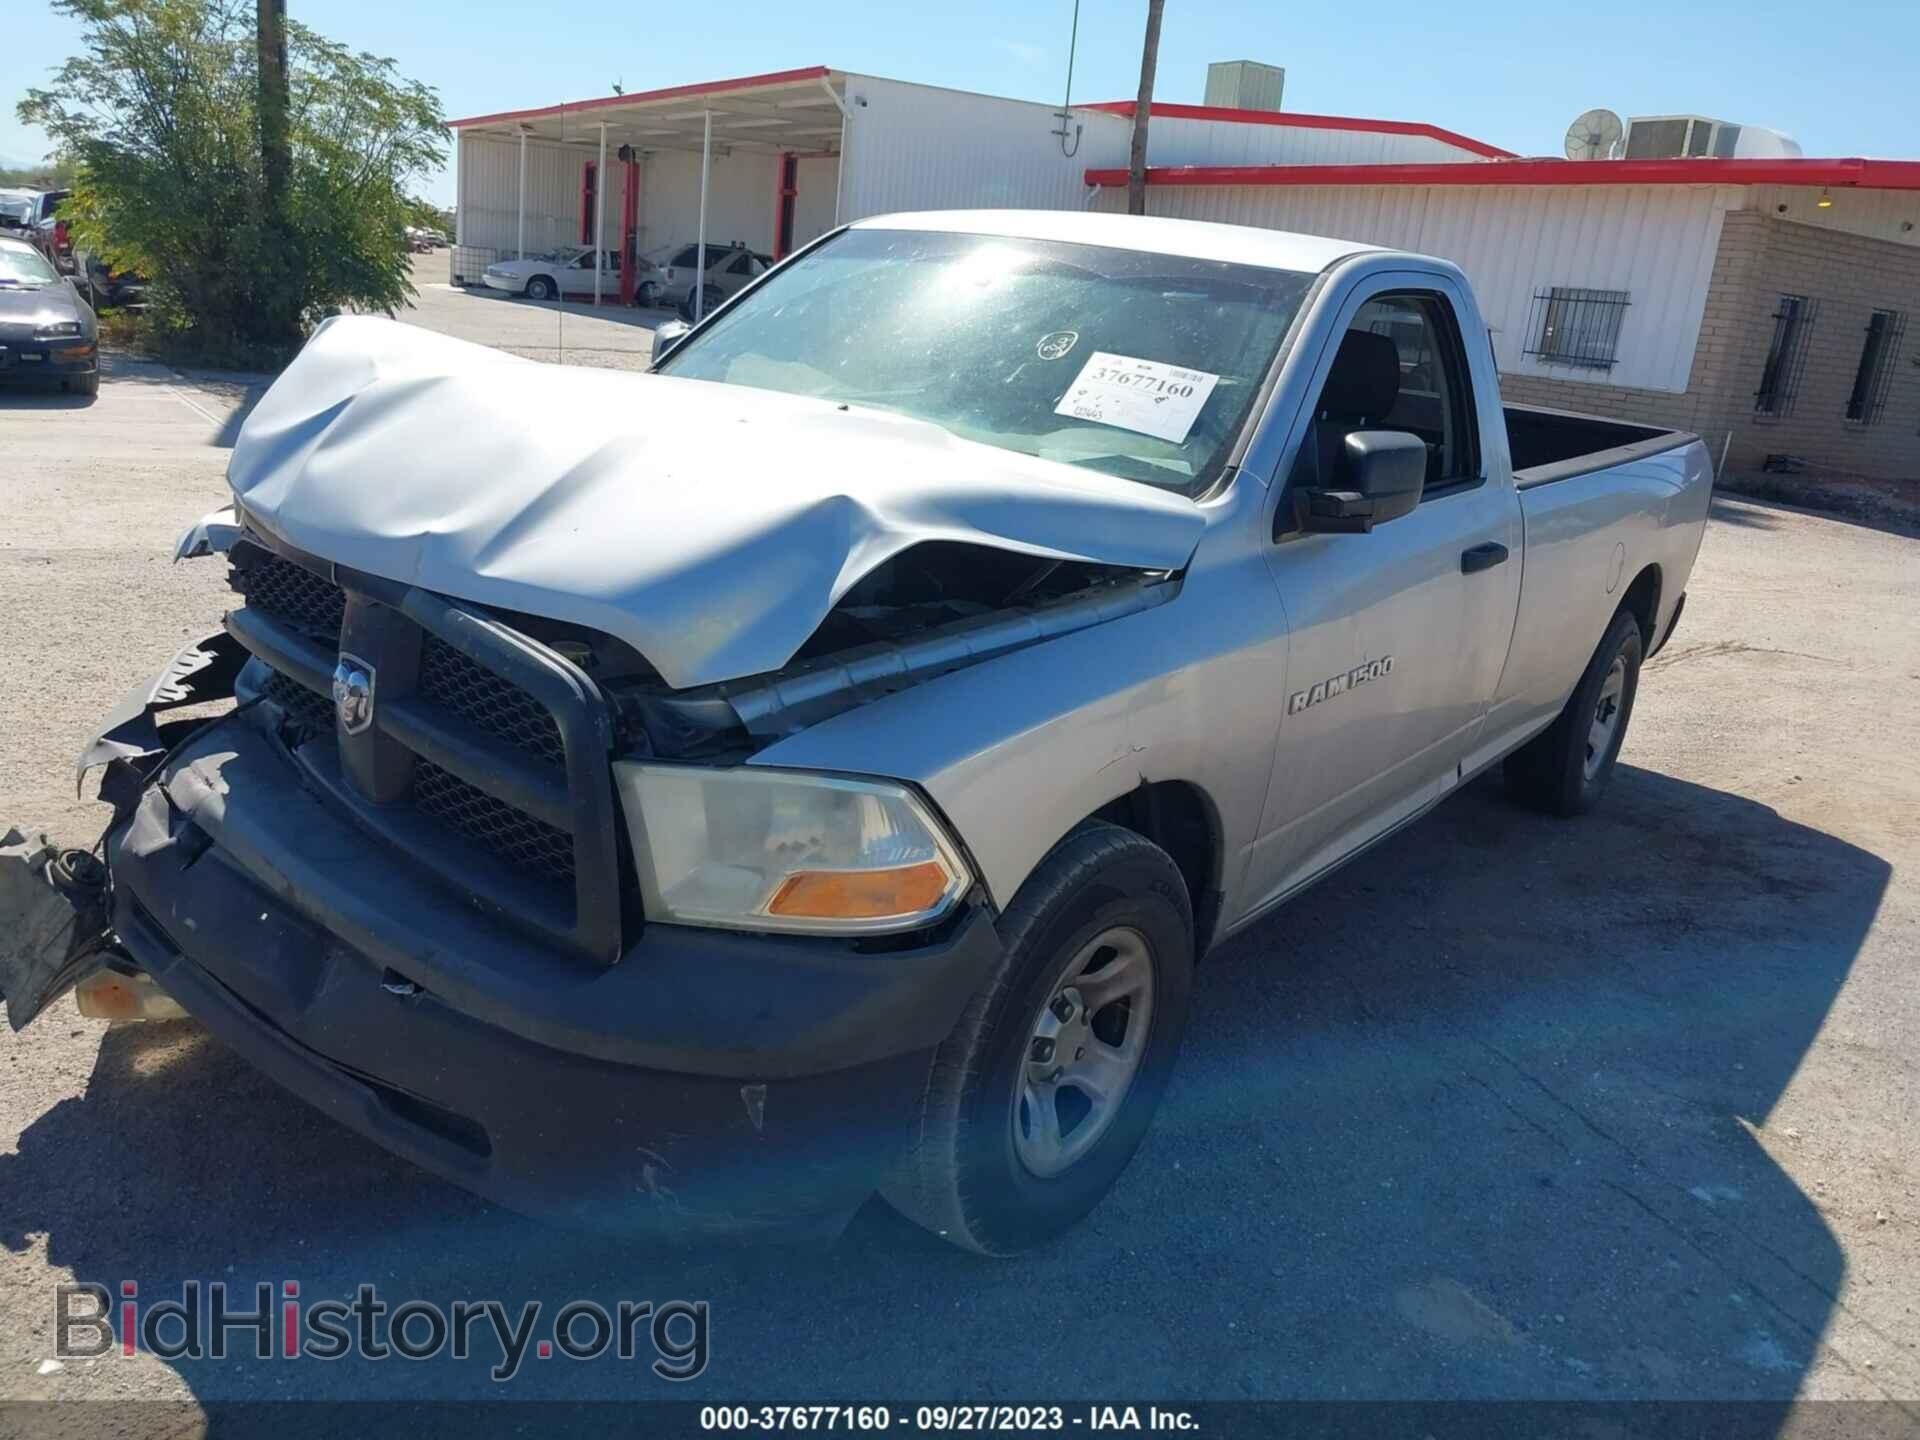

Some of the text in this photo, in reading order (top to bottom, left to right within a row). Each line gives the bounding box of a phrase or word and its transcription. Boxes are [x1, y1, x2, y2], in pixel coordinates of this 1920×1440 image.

[1091, 367, 1194, 399] 37677160
[1288, 655, 1395, 715] RAM 1500
